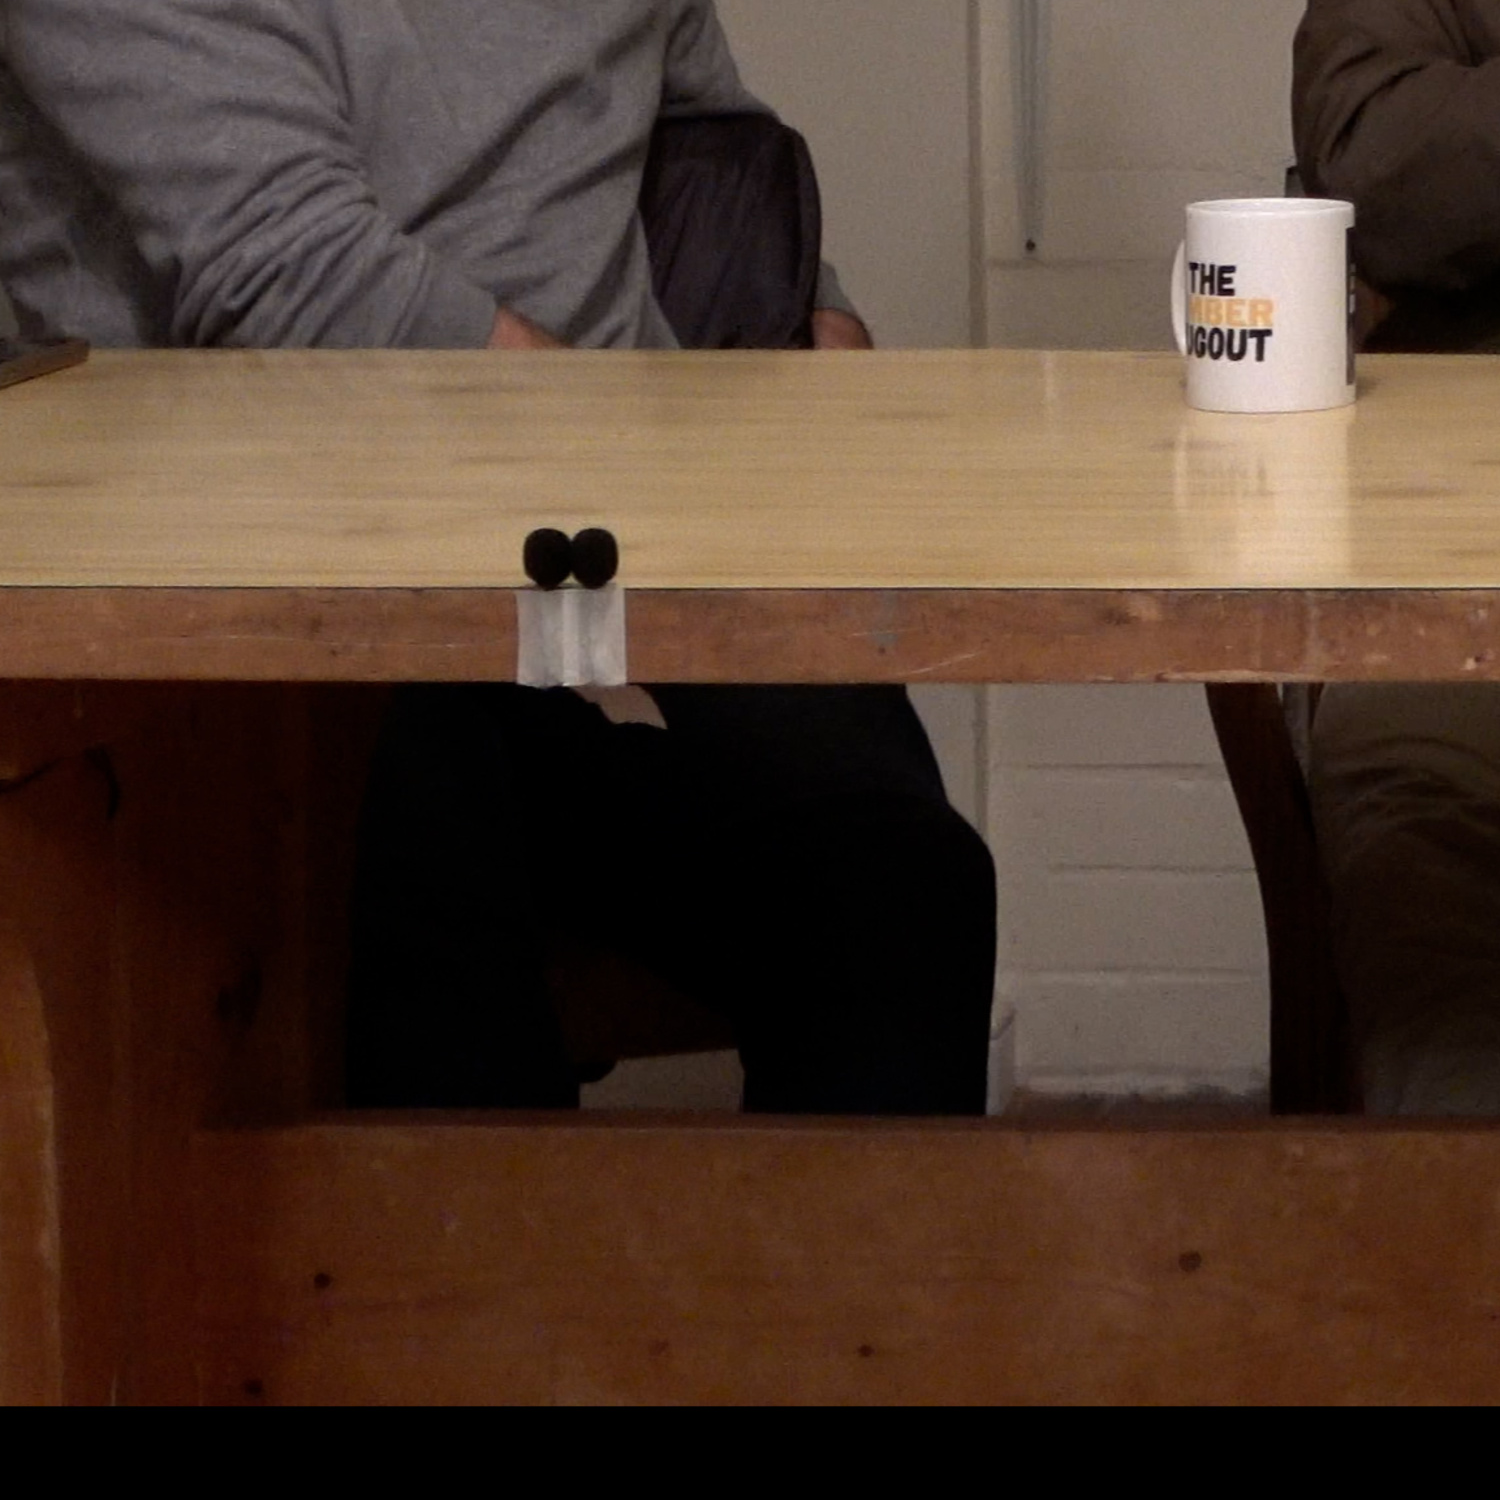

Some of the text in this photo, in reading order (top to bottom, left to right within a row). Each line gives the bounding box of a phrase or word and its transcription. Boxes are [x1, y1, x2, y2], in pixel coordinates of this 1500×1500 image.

[1188, 262, 1237, 297] THE
[1187, 296, 1274, 327] MBER
[1186, 324, 1273, 362] UGOUT
